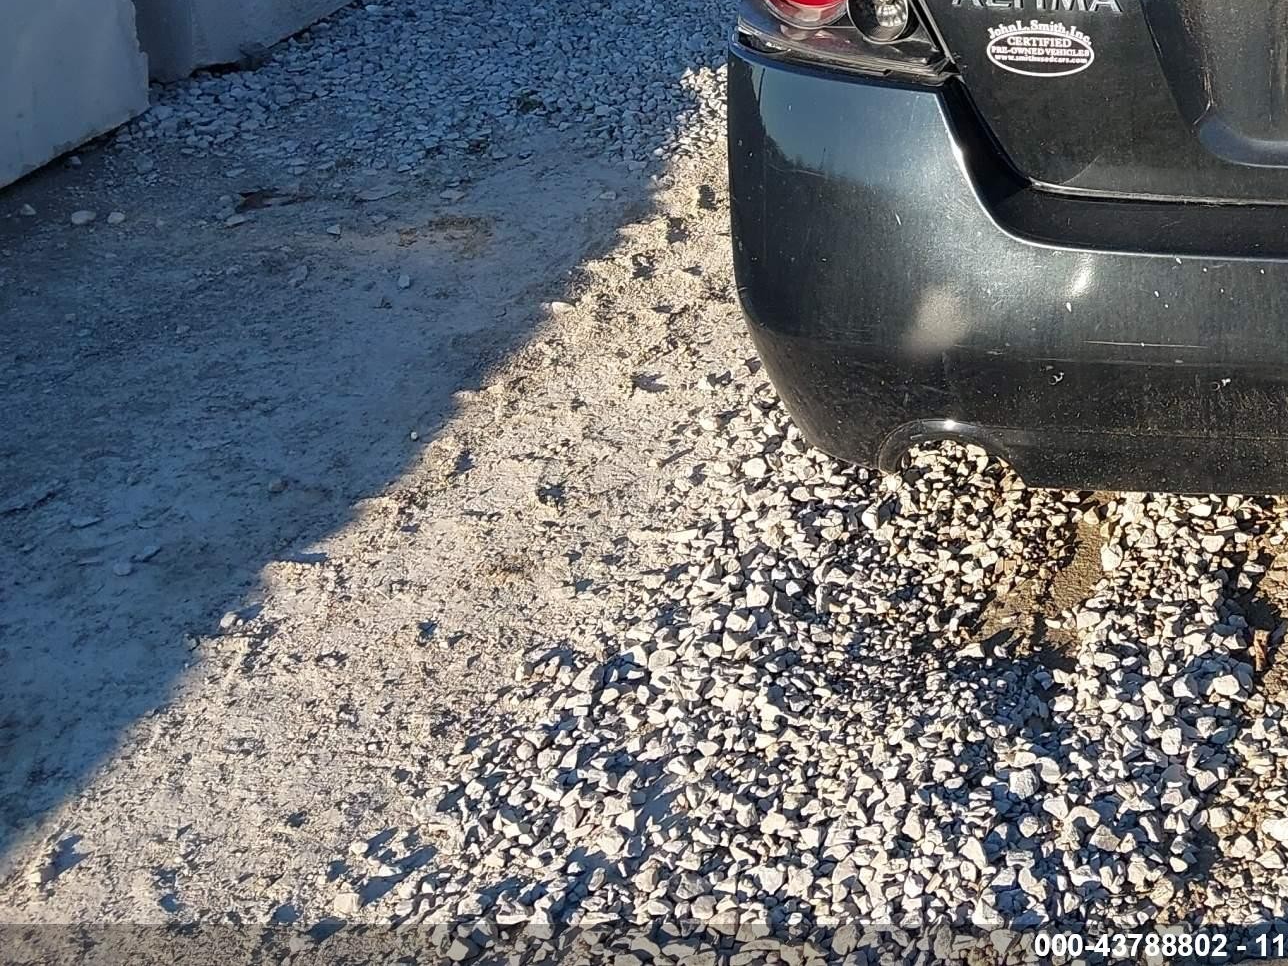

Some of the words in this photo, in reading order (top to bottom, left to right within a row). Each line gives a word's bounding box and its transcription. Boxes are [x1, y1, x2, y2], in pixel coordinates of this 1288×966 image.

[987, 23, 1017, 40] John
[1070, 25, 1093, 46] Inc.
[1006, 36, 1072, 48] CERTIFIED
[991, 45, 1045, 56] PRE-OWNED
[1044, 47, 1090, 57] VEHICLES
